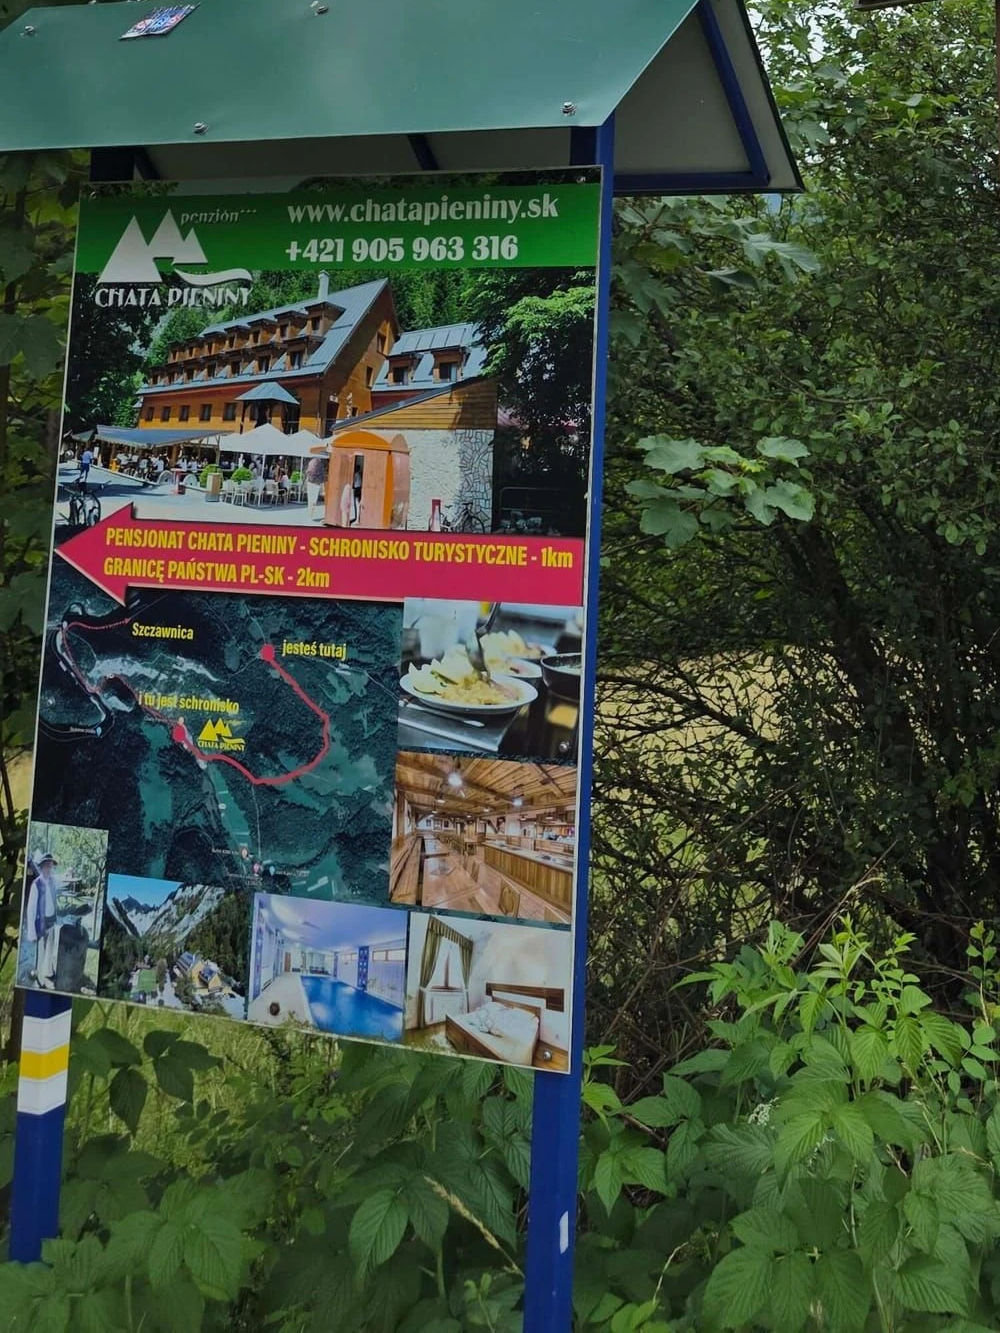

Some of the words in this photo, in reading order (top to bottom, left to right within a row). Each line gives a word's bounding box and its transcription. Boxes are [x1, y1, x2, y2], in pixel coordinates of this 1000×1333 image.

[287, 193, 559, 226] www.chatapieniny.sk
[285, 238, 345, 263] +421
[352, 237, 405, 262] 905
[412, 236, 465, 261] 963
[471, 234, 519, 260] 316
[95, 287, 161, 308] CHATA
[167, 286, 254, 308] PIENINY
[106, 527, 186, 551] PENSJONAT
[187, 531, 234, 553] CHATA
[237, 533, 297, 556] PIENINY
[309, 537, 410, 561] SCHRONISKO
[413, 541, 528, 566] TURYSTYCZNE
[541, 546, 573, 569] 1km
[103, 559, 165, 584] GRANICĘ
[167, 559, 237, 583] PAŃSTWA
[241, 565, 285, 586] PL-SK
[297, 568, 330, 588] 2km
[132, 621, 194, 640] Szczawnica
[282, 639, 317, 657] jesteś
[318, 641, 347, 660] tutaj
